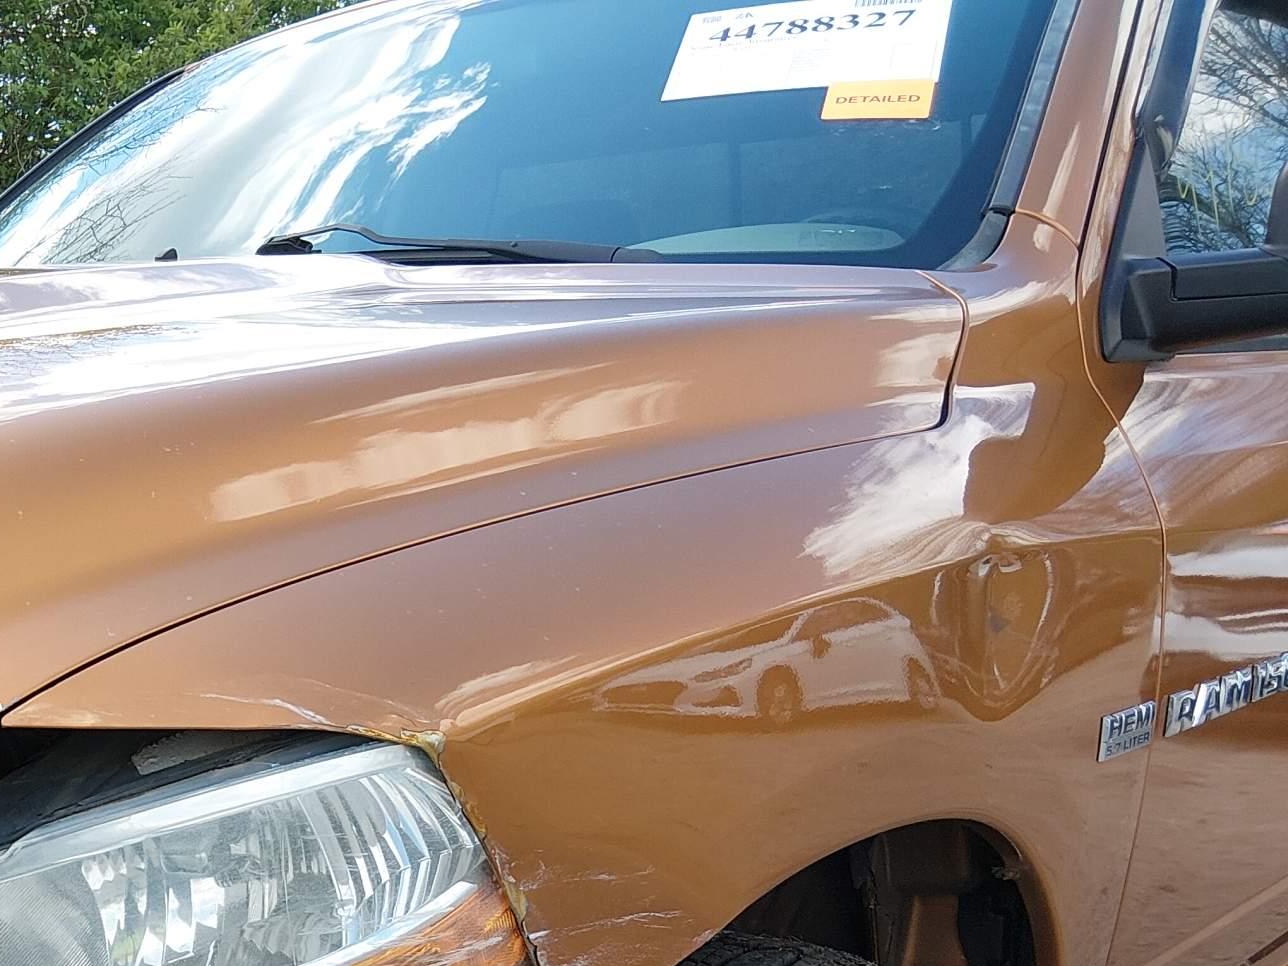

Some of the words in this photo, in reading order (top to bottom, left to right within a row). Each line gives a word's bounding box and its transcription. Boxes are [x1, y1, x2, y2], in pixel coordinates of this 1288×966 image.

[708, 9, 916, 42] 44788327
[834, 94, 921, 105] DETAILED
[1164, 663, 1253, 738] RAM
[1252, 651, 1288, 702] 15
[1106, 703, 1156, 740] HEMI
[1123, 731, 1150, 751] LITER
